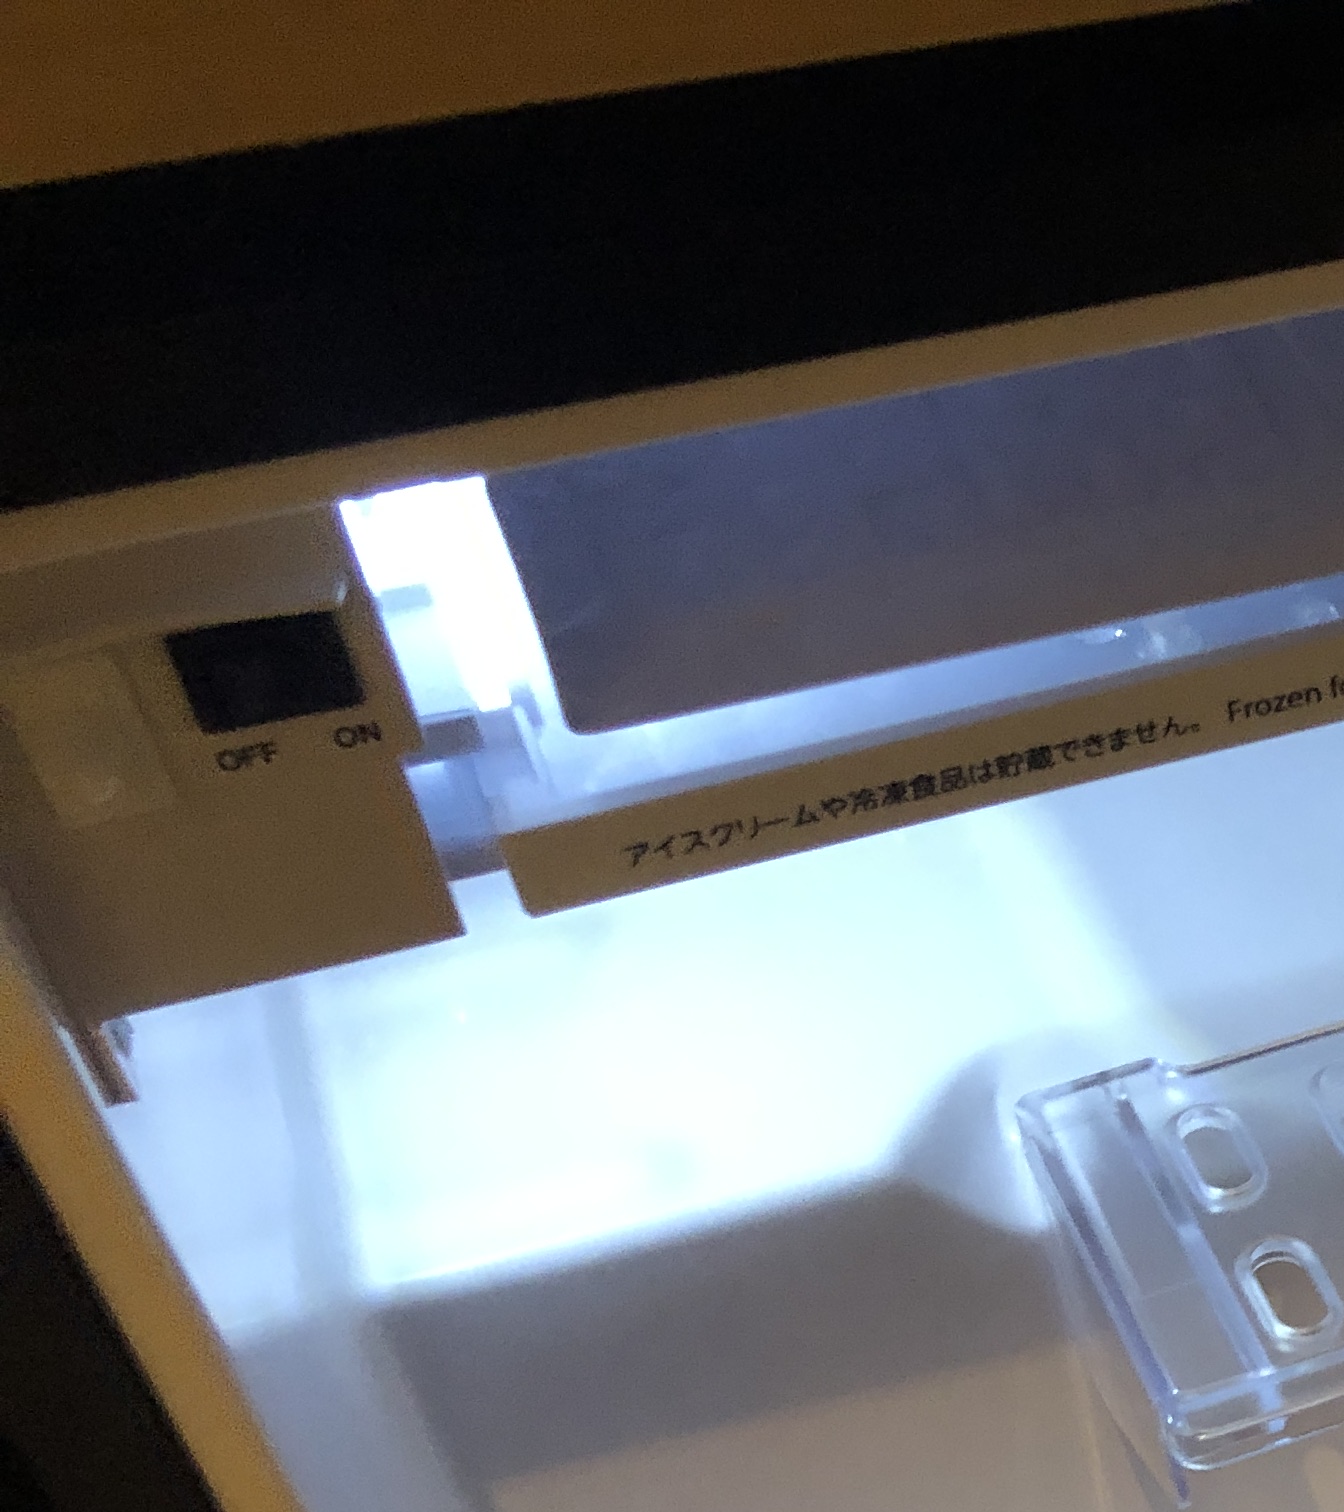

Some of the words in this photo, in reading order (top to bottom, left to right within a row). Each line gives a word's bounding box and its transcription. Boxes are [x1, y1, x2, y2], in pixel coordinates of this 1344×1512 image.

[1227, 681, 1323, 724] Frozen
[333, 719, 382, 749] ON
[214, 740, 277, 772] OFF
[624, 715, 1200, 867] アイスクリームや冷凍食品は貯蔵できません。
